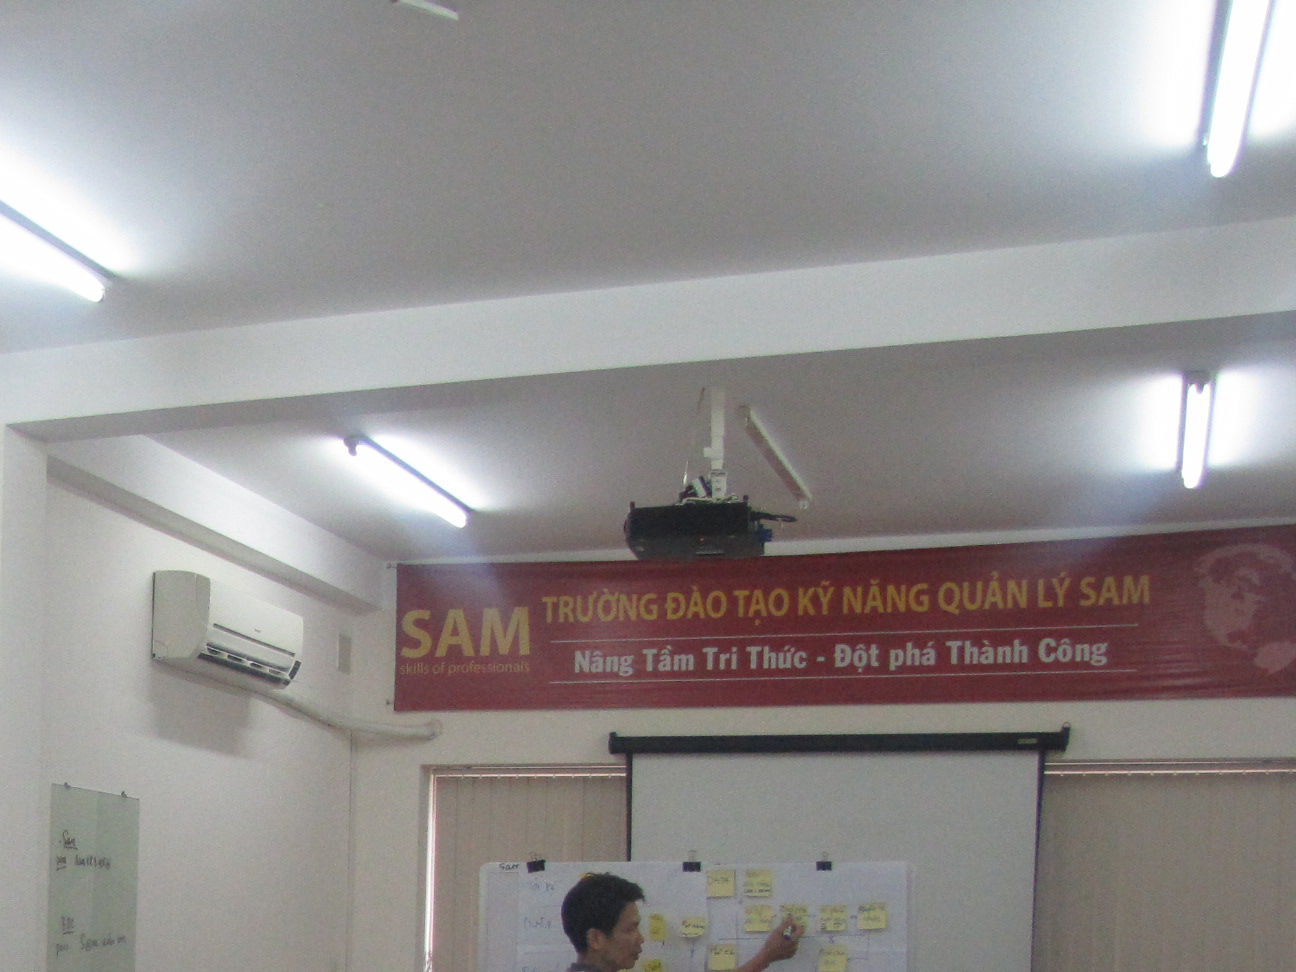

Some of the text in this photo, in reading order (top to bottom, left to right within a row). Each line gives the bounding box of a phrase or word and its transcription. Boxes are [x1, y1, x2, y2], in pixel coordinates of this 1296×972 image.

[542, 572, 1151, 626] TRƯỜNG ĐÀO TẠO KỸ NĂNG QUẢN LÝ SAM
[401, 606, 531, 660] SAM
[400, 660, 531, 676] skills of professionals
[574, 649, 634, 677] Nâng
[642, 645, 694, 673] Tầm
[702, 647, 738, 671] Tri
[745, 644, 807, 670] Thức
[834, 643, 881, 673] Đột
[889, 642, 937, 671] phá
[946, 639, 1029, 666] Thành
[1038, 637, 1109, 666] Công
